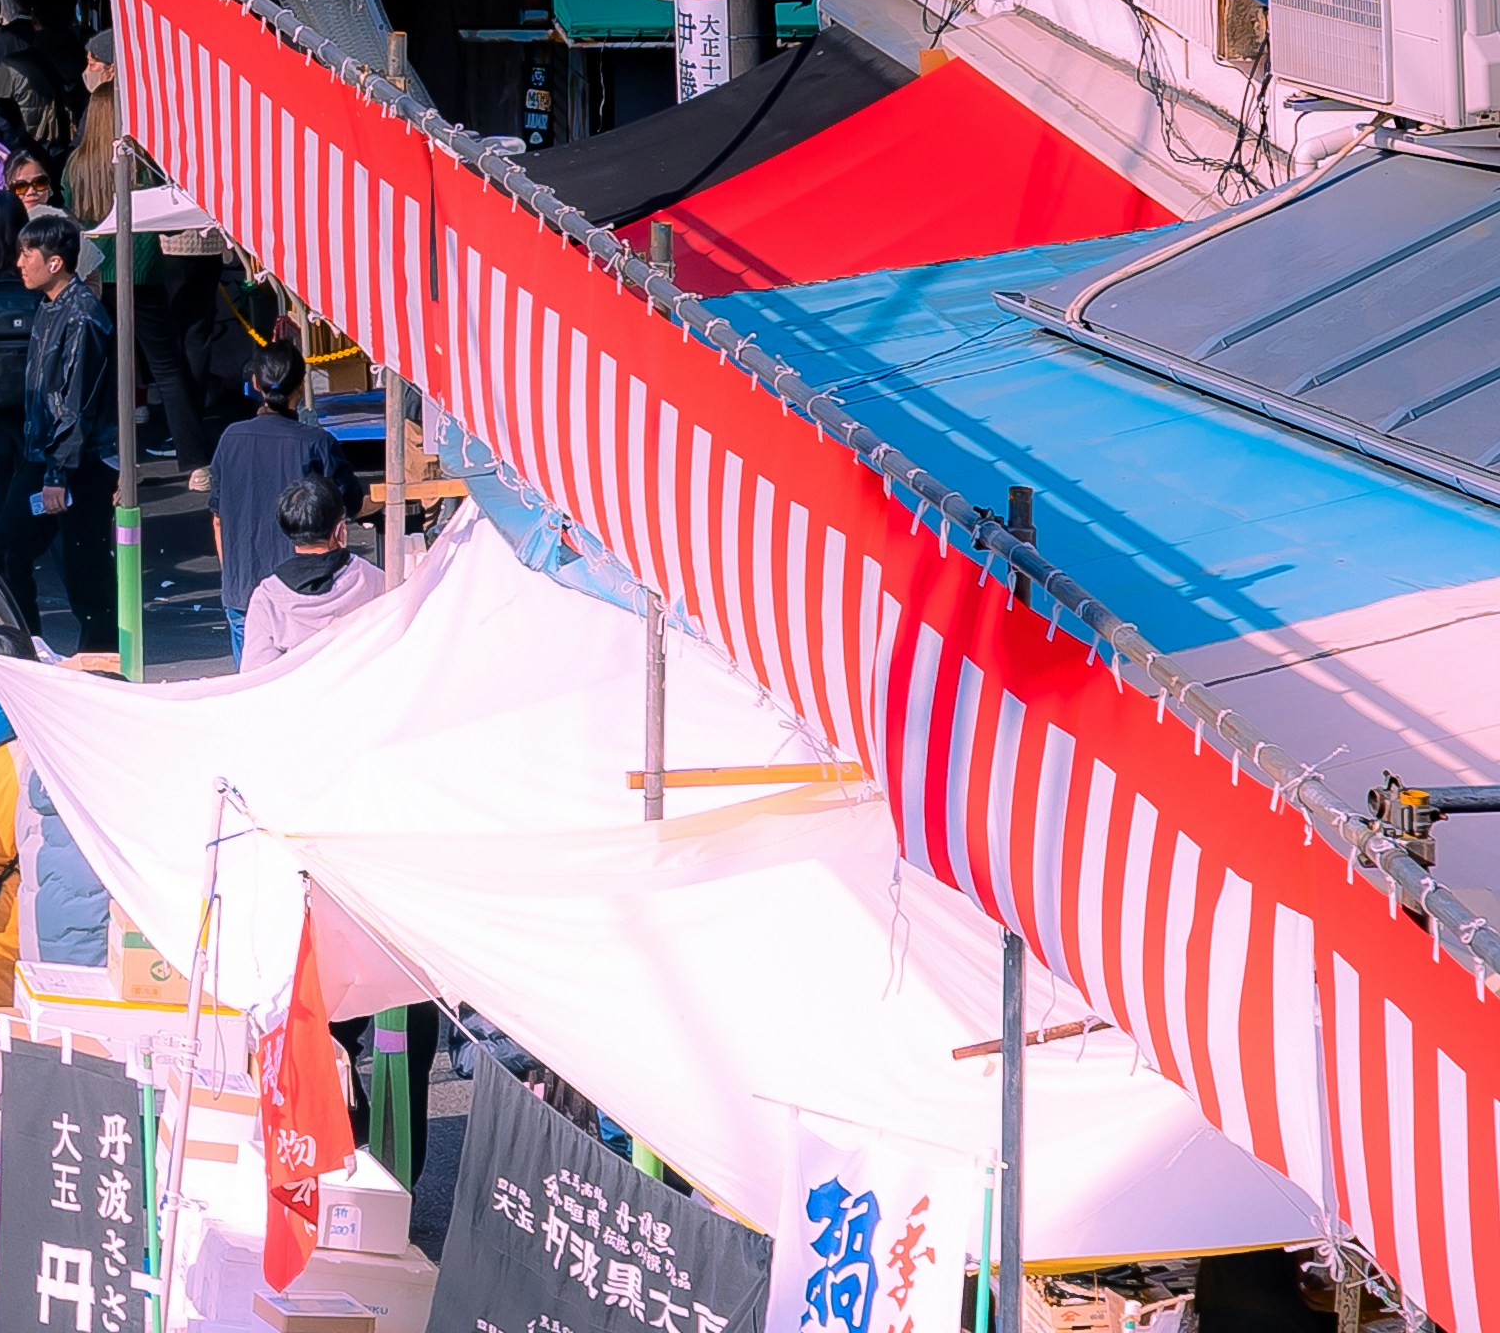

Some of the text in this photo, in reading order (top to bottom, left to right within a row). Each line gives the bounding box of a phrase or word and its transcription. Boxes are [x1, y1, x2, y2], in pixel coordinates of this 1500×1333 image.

[50, 1112, 83, 1213] 大玉
[97, 1112, 134, 1333] 丹波ささ
